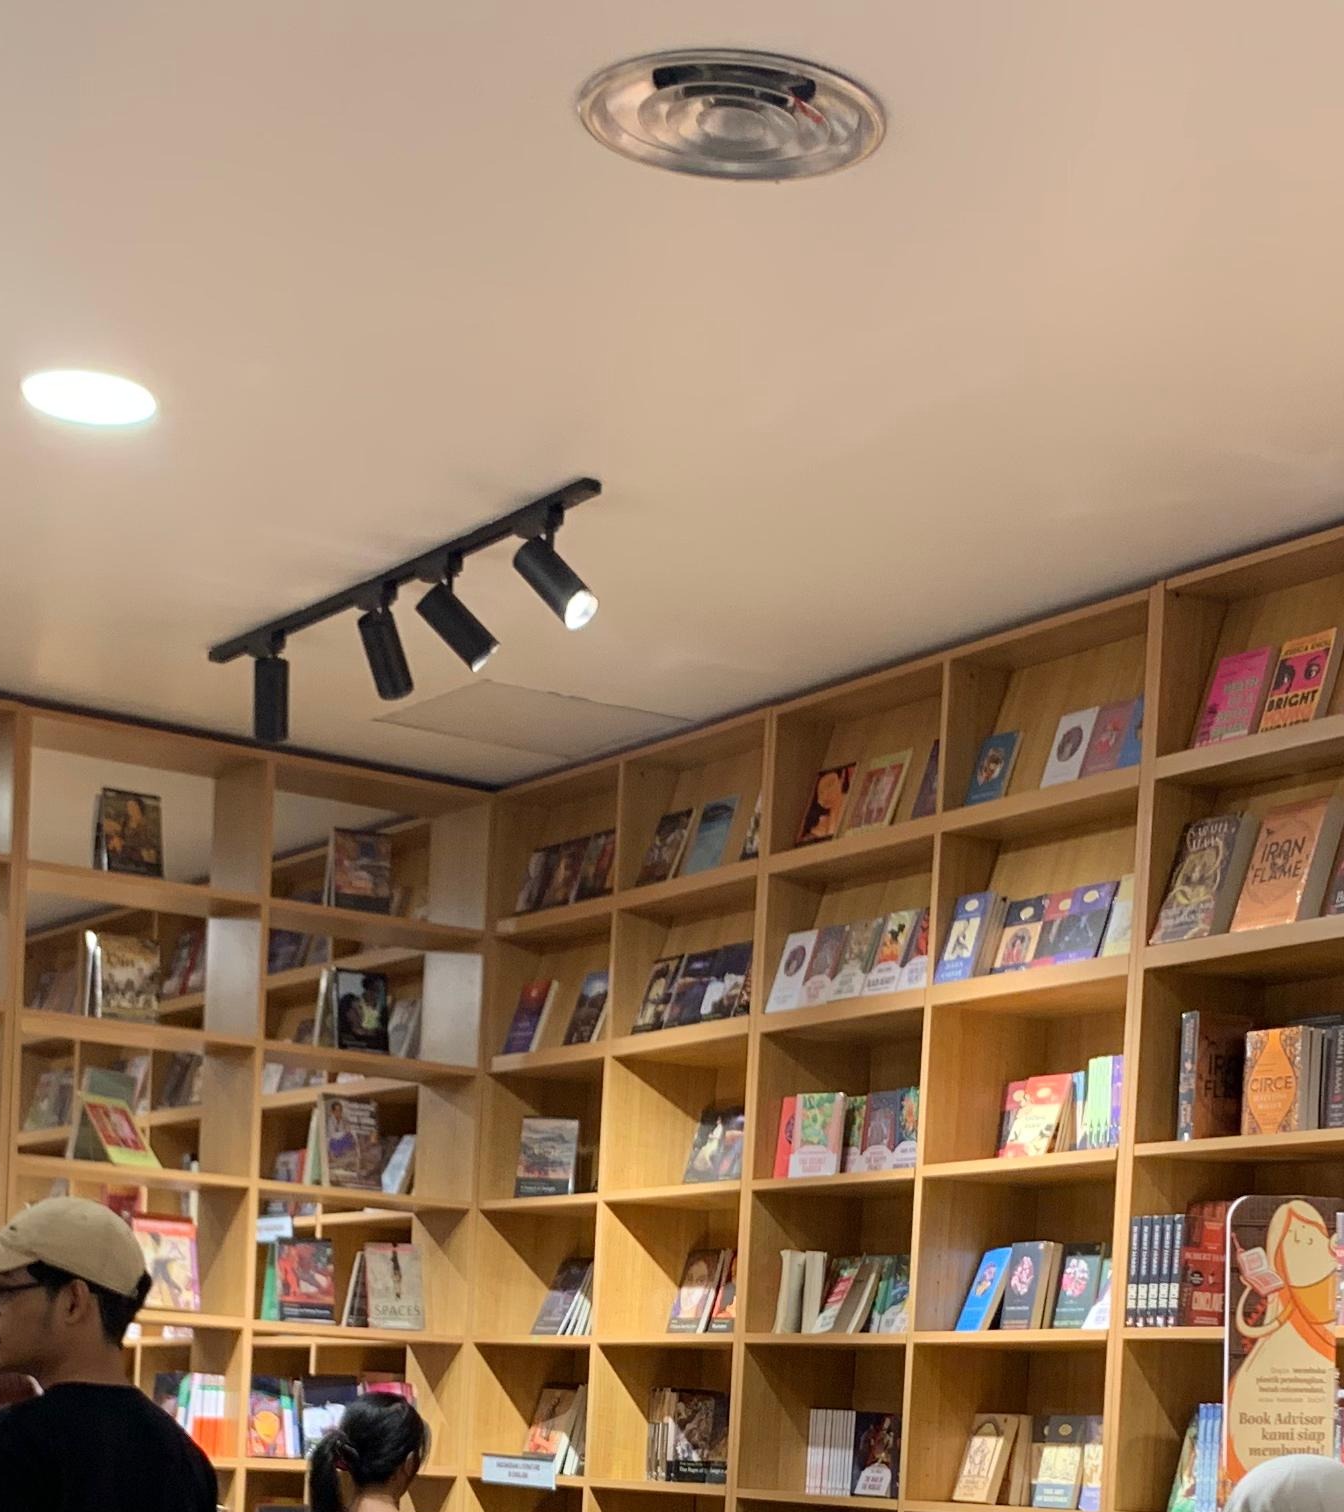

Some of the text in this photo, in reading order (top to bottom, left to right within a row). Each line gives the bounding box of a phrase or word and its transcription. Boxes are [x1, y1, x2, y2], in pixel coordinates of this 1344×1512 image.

[1267, 689, 1318, 712] BRIGHT
[1261, 836, 1307, 864] IRON
[1253, 860, 1303, 885] FLAME
[1250, 1075, 1293, 1091] CIRCE
[373, 1303, 422, 1317] SPACES
[1239, 1412, 1325, 1426] Book Advisor
[1261, 1428, 1325, 1443] kami siap
